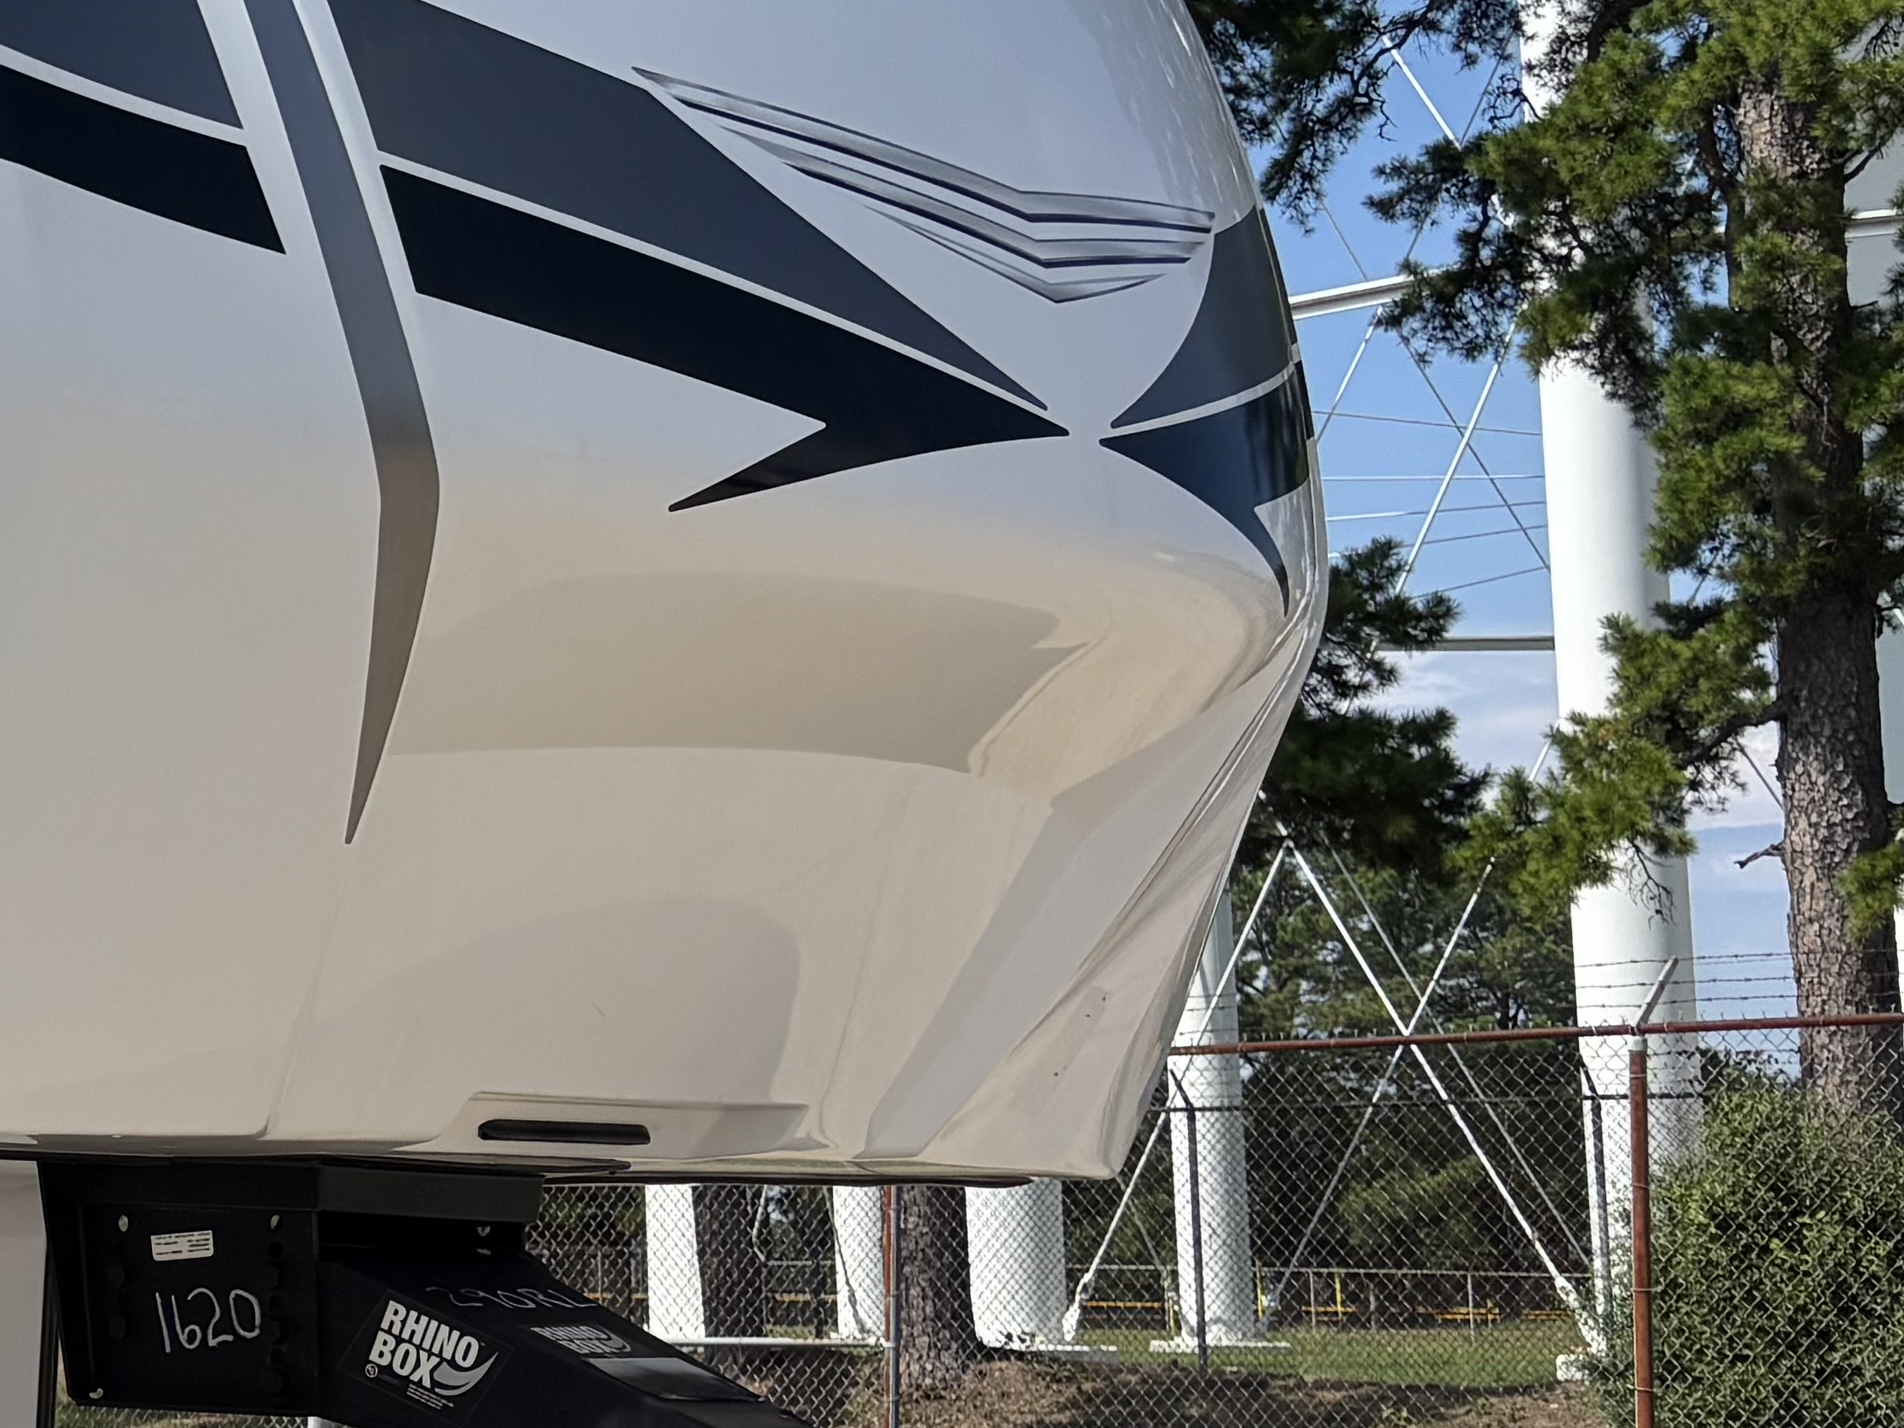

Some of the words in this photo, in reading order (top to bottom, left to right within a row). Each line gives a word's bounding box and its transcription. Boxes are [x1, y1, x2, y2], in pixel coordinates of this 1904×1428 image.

[155, 1287, 261, 1353] 1620
[380, 1300, 480, 1368] RHINO
[368, 1330, 441, 1389] BOX
